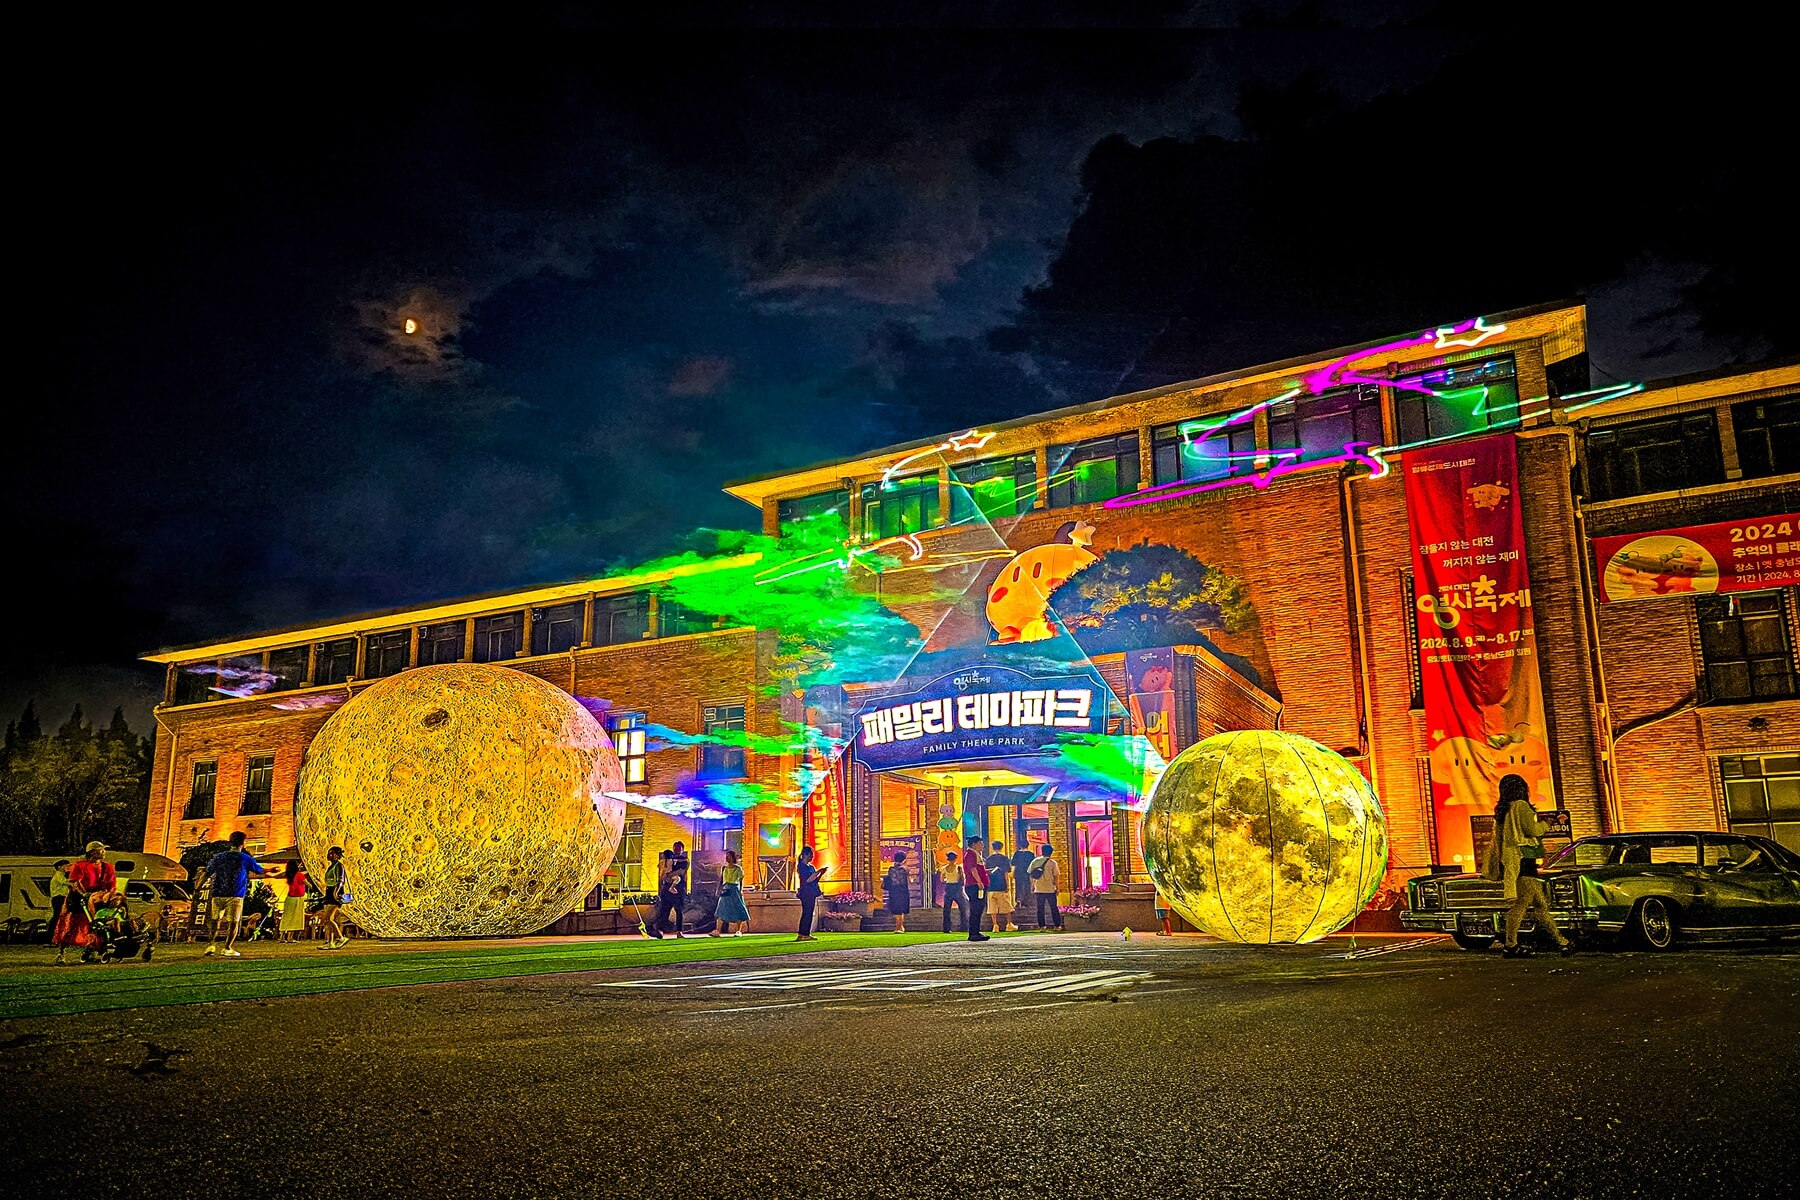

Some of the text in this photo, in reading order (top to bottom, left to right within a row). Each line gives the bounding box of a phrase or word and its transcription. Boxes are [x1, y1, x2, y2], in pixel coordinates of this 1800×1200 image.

[1729, 521, 1793, 543] 2024
[1419, 535, 1494, 554] 잠들지 않는 대전
[1732, 543, 1773, 558] 추억의
[1443, 550, 1519, 568] 꺼지지 않는 재미
[1735, 563, 1755, 573] 장소
[1736, 574, 1756, 583] 기간
[861, 689, 1092, 747] 패밀리 테마파크
[923, 737, 1025, 754] FAMILY THEME PARK
